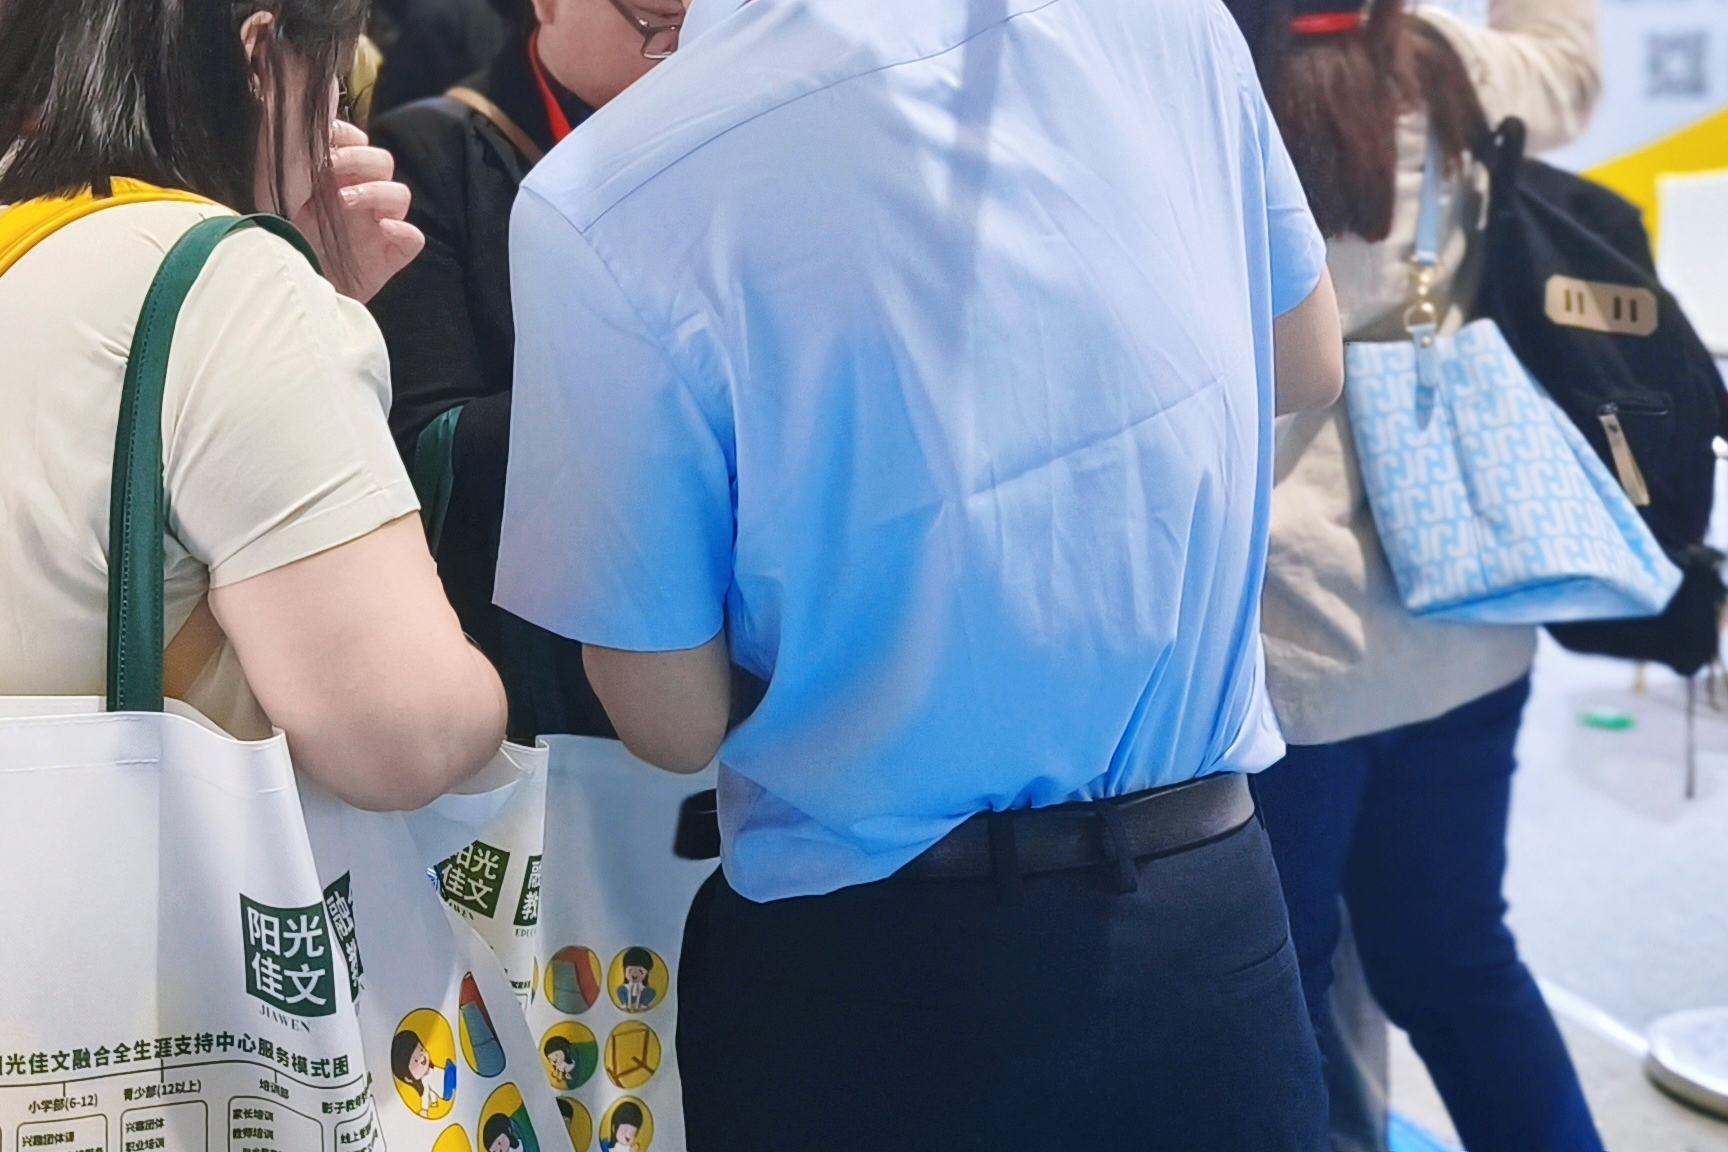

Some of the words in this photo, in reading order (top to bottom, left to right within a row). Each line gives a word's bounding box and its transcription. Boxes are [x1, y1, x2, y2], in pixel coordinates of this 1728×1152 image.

[441, 863, 494, 910] 佳文
[246, 906, 325, 959] 阳光
[251, 952, 328, 1007] 佳文
[258, 1003, 312, 1033] JIAWEN
